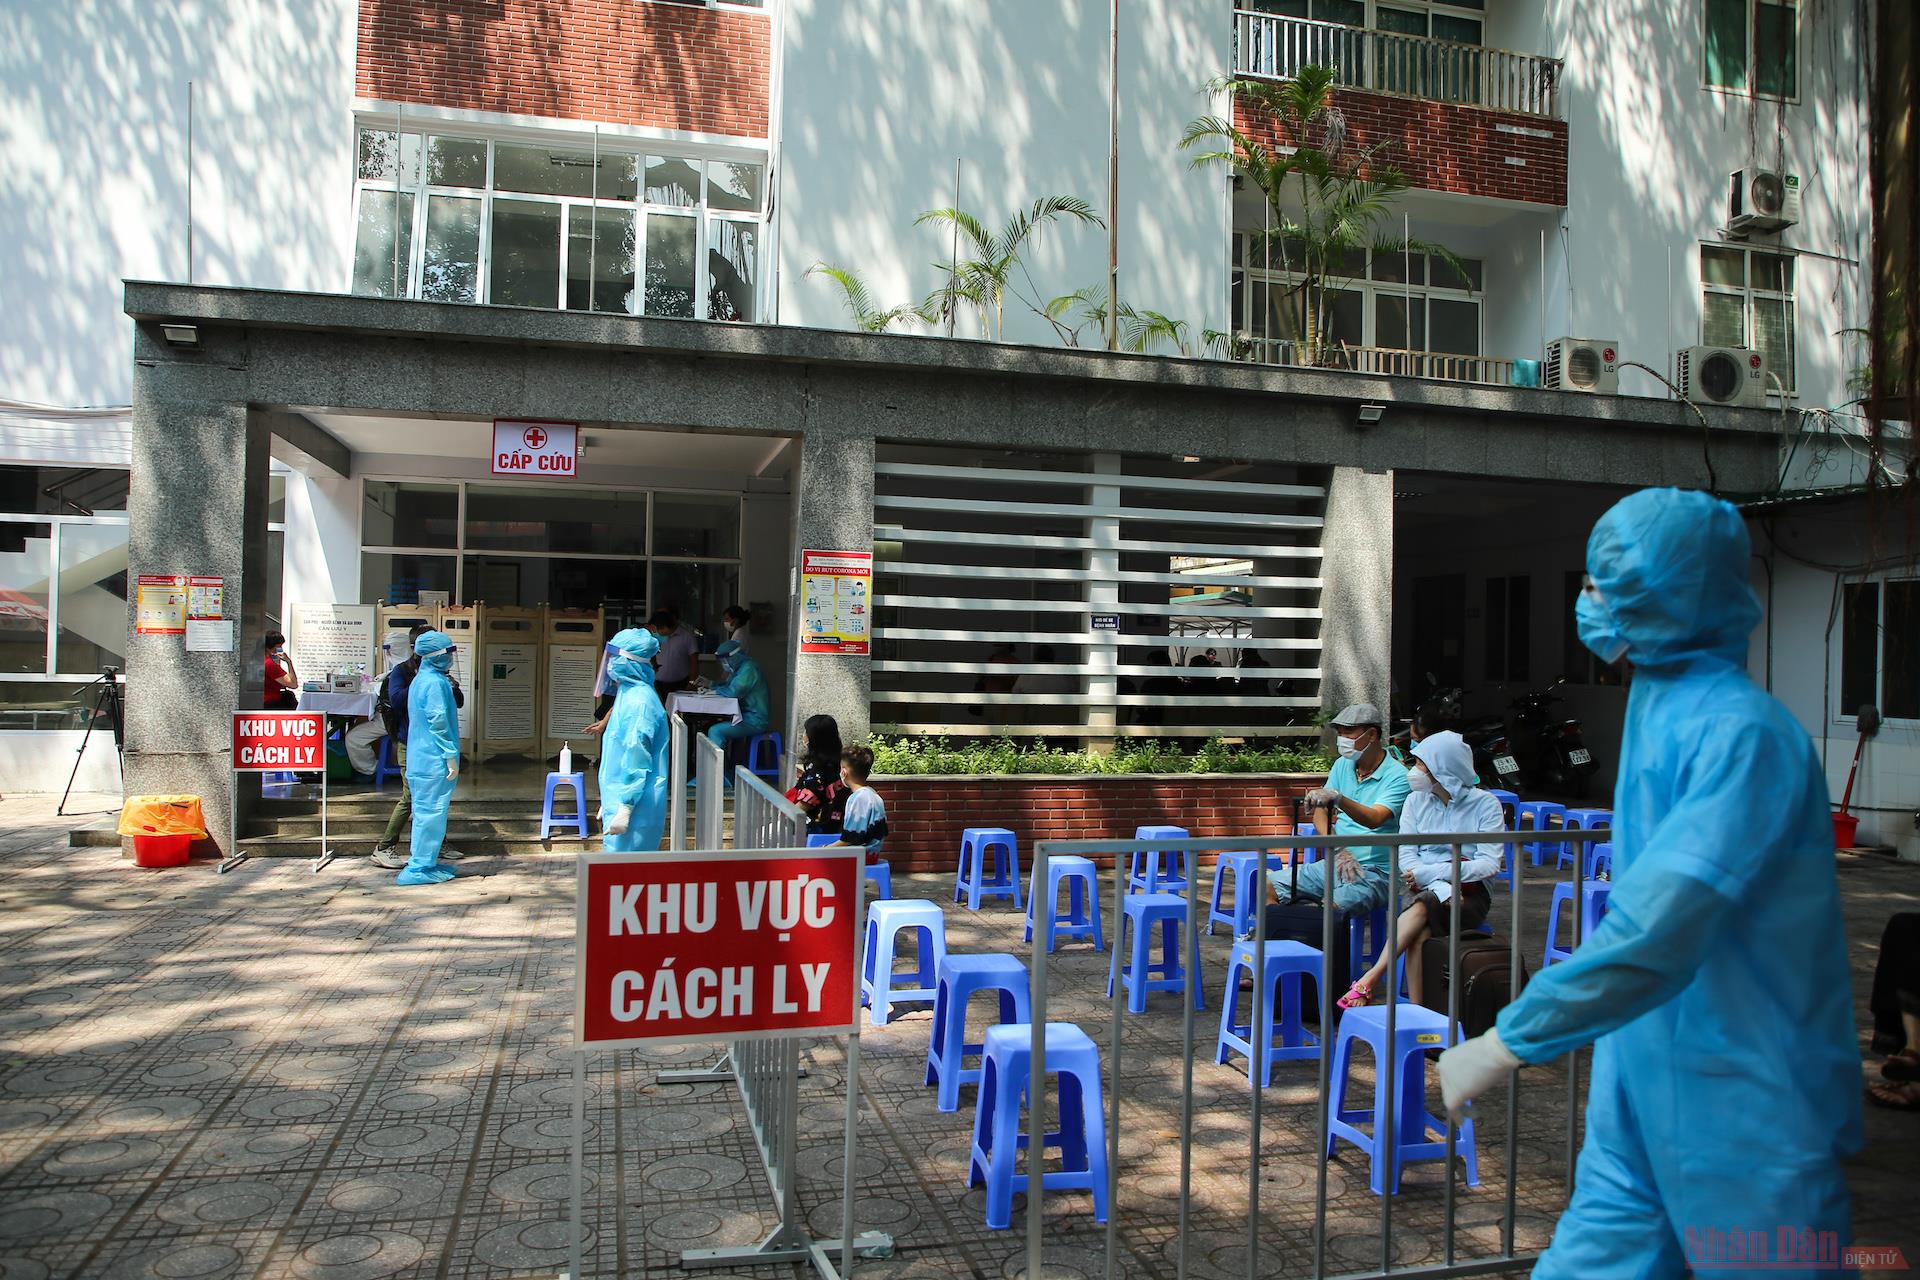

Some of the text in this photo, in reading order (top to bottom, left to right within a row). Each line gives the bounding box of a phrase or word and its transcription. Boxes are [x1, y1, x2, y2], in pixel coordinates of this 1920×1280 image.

[498, 448, 572, 471] CẤP CỨU
[239, 718, 316, 741] KHU VỰC
[241, 743, 316, 764] CÁCH LY
[608, 873, 836, 943] KHU VỰC
[609, 957, 831, 1024] CÁCH LY
